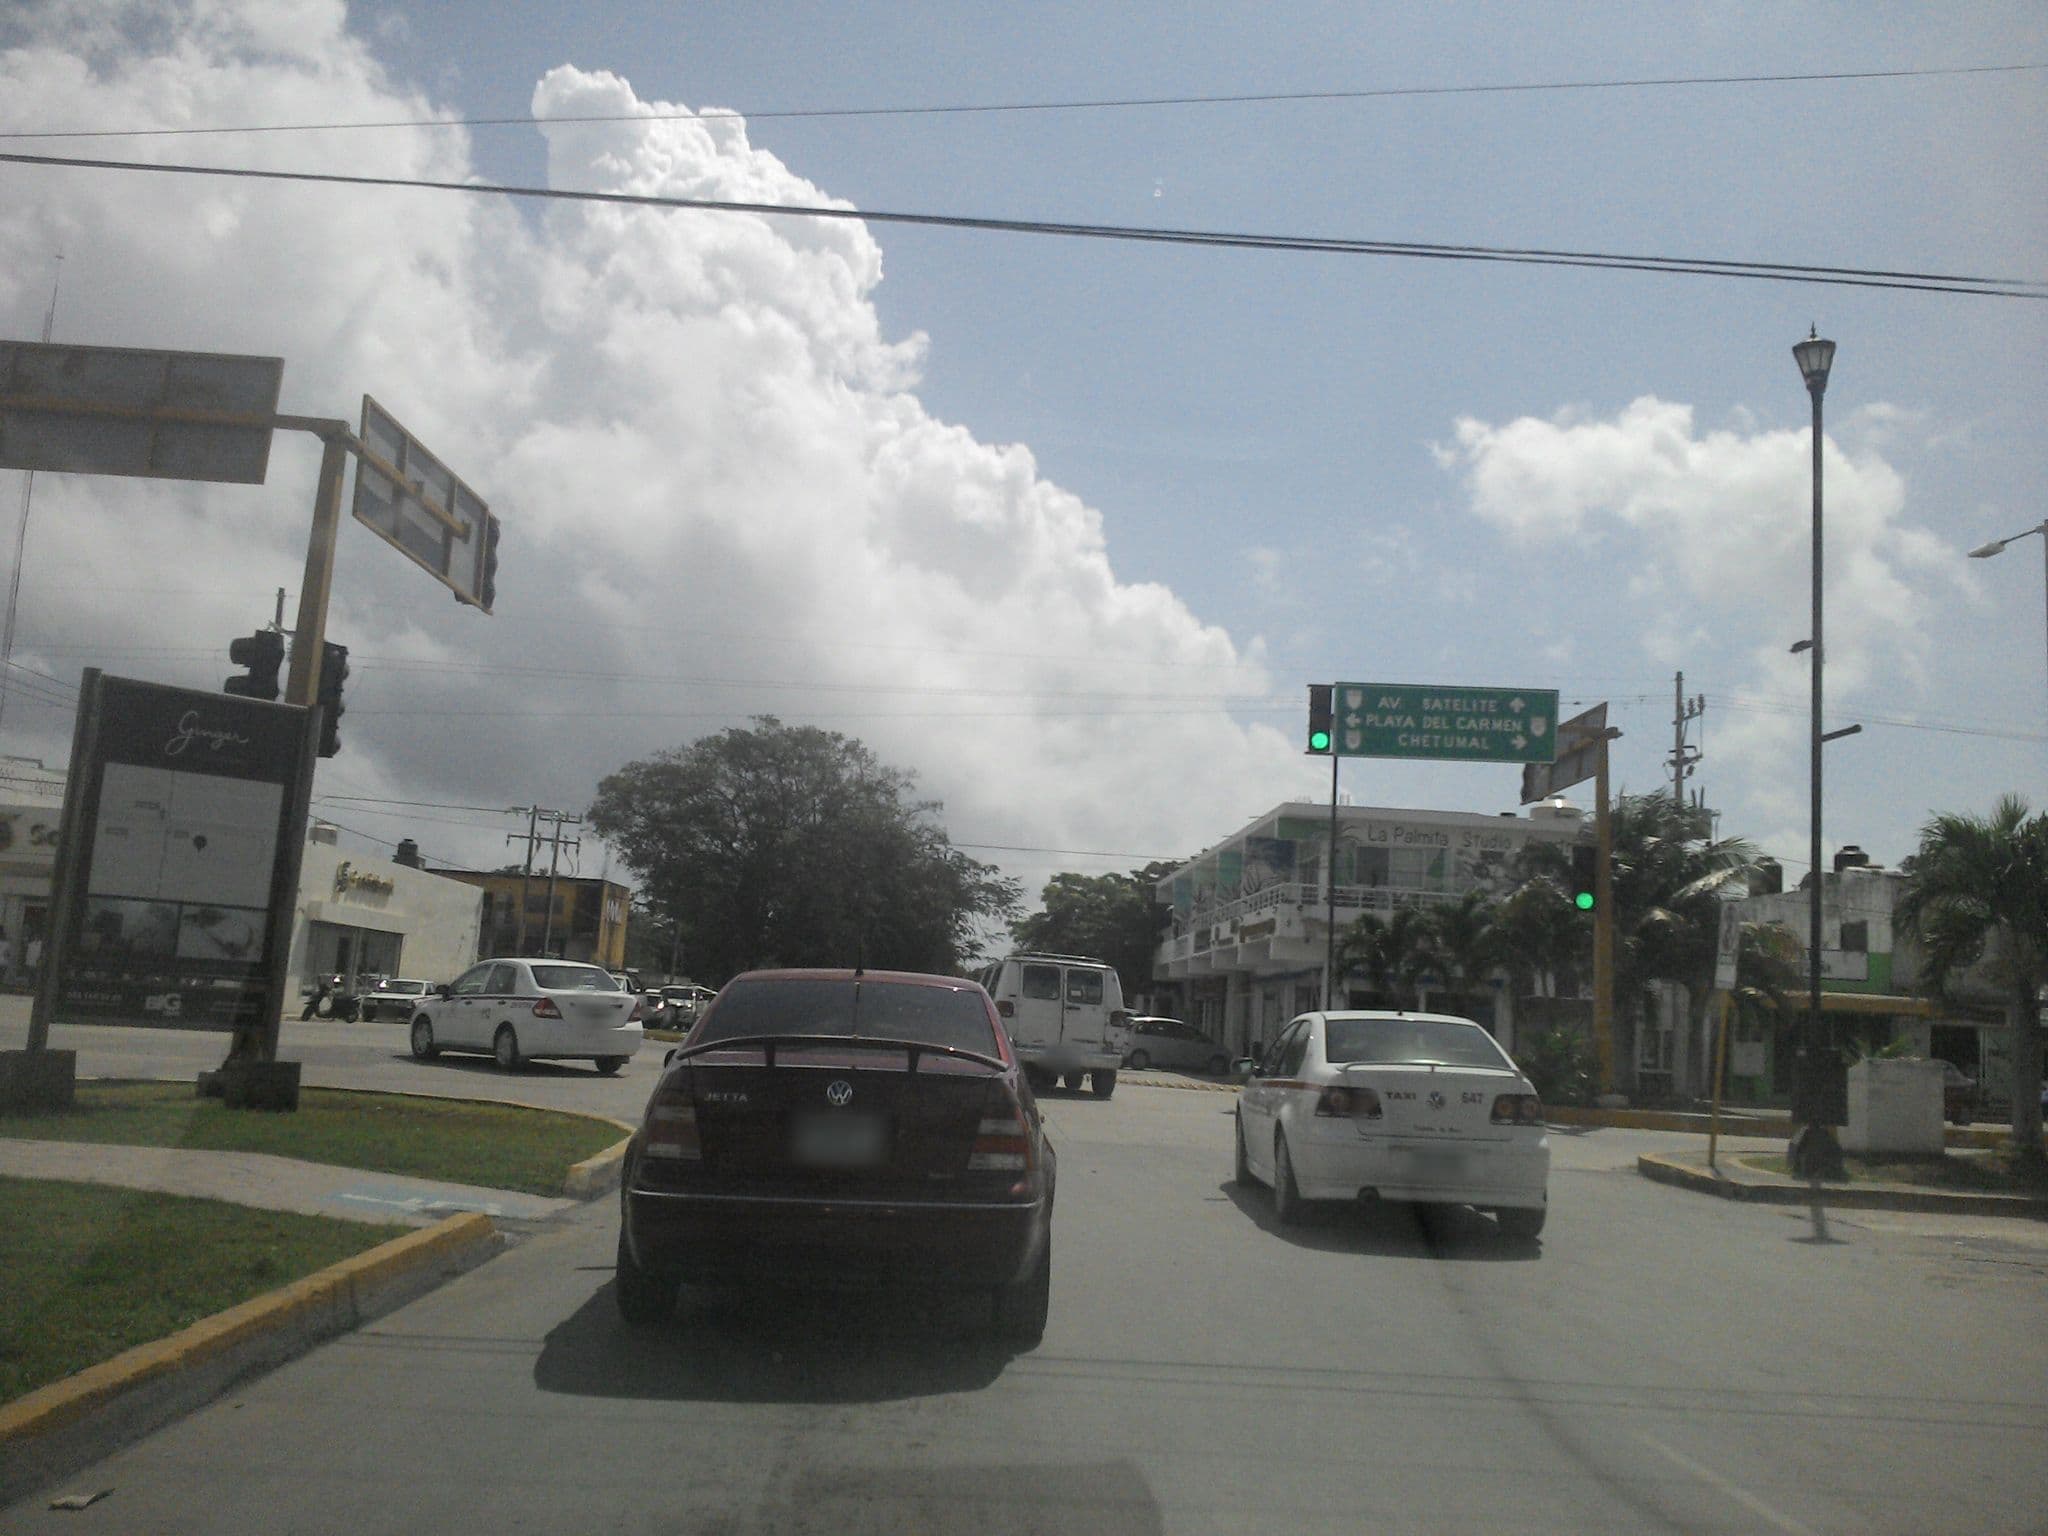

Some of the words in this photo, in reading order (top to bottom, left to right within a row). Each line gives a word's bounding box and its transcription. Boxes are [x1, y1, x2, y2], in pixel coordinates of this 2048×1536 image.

[1422, 698, 1497, 713] SATELITE
[1366, 714, 1416, 728] PLAYA
[1422, 715, 1449, 730] DEL
[1456, 716, 1522, 732] CARMEN
[1399, 734, 1489, 749] CHETUMAL
[1368, 824, 1388, 842] La
[1393, 826, 1449, 847] Palmita
[1384, 1091, 1417, 1100] TAXI
